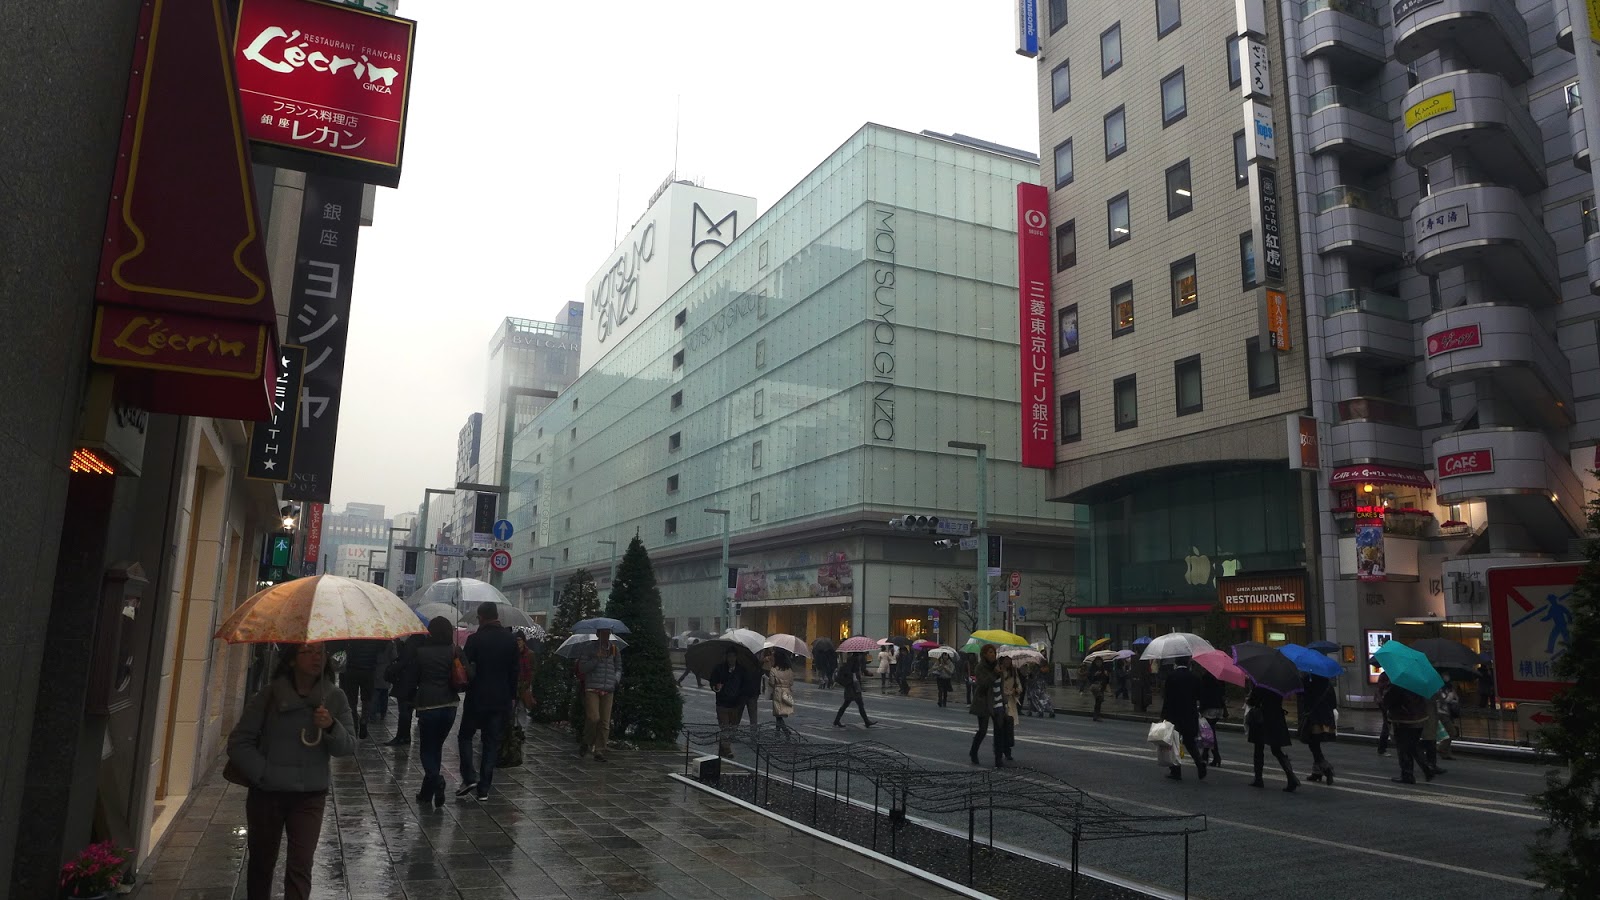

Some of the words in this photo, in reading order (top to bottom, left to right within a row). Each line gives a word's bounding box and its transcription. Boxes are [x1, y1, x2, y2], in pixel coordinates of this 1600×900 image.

[304, 33, 355, 52] RESTAURANT
[361, 46, 402, 62] FRANÇAIS
[362, 82, 392, 95] GINZA
[273, 101, 359, 128] フランス料理店
[260, 114, 291, 129] 銀座
[291, 120, 367, 150] レカン
[1254, 119, 1273, 140] Top's
[320, 203, 343, 247] 銀座
[1263, 196, 1272, 231] POLE
[1269, 198, 1278, 232] METRO
[1265, 233, 1281, 267] 紅虎
[296, 260, 340, 428] ヨシノヤ
[513, 335, 579, 352] BVLGAR
[1030, 281, 1049, 440] 三菱東京UFJ銀行
[294, 472, 319, 482] NCE
[495, 555, 508, 566] 50
[1226, 593, 1295, 604] RESTAURANTS
[1519, 660, 1552, 678] 横断
